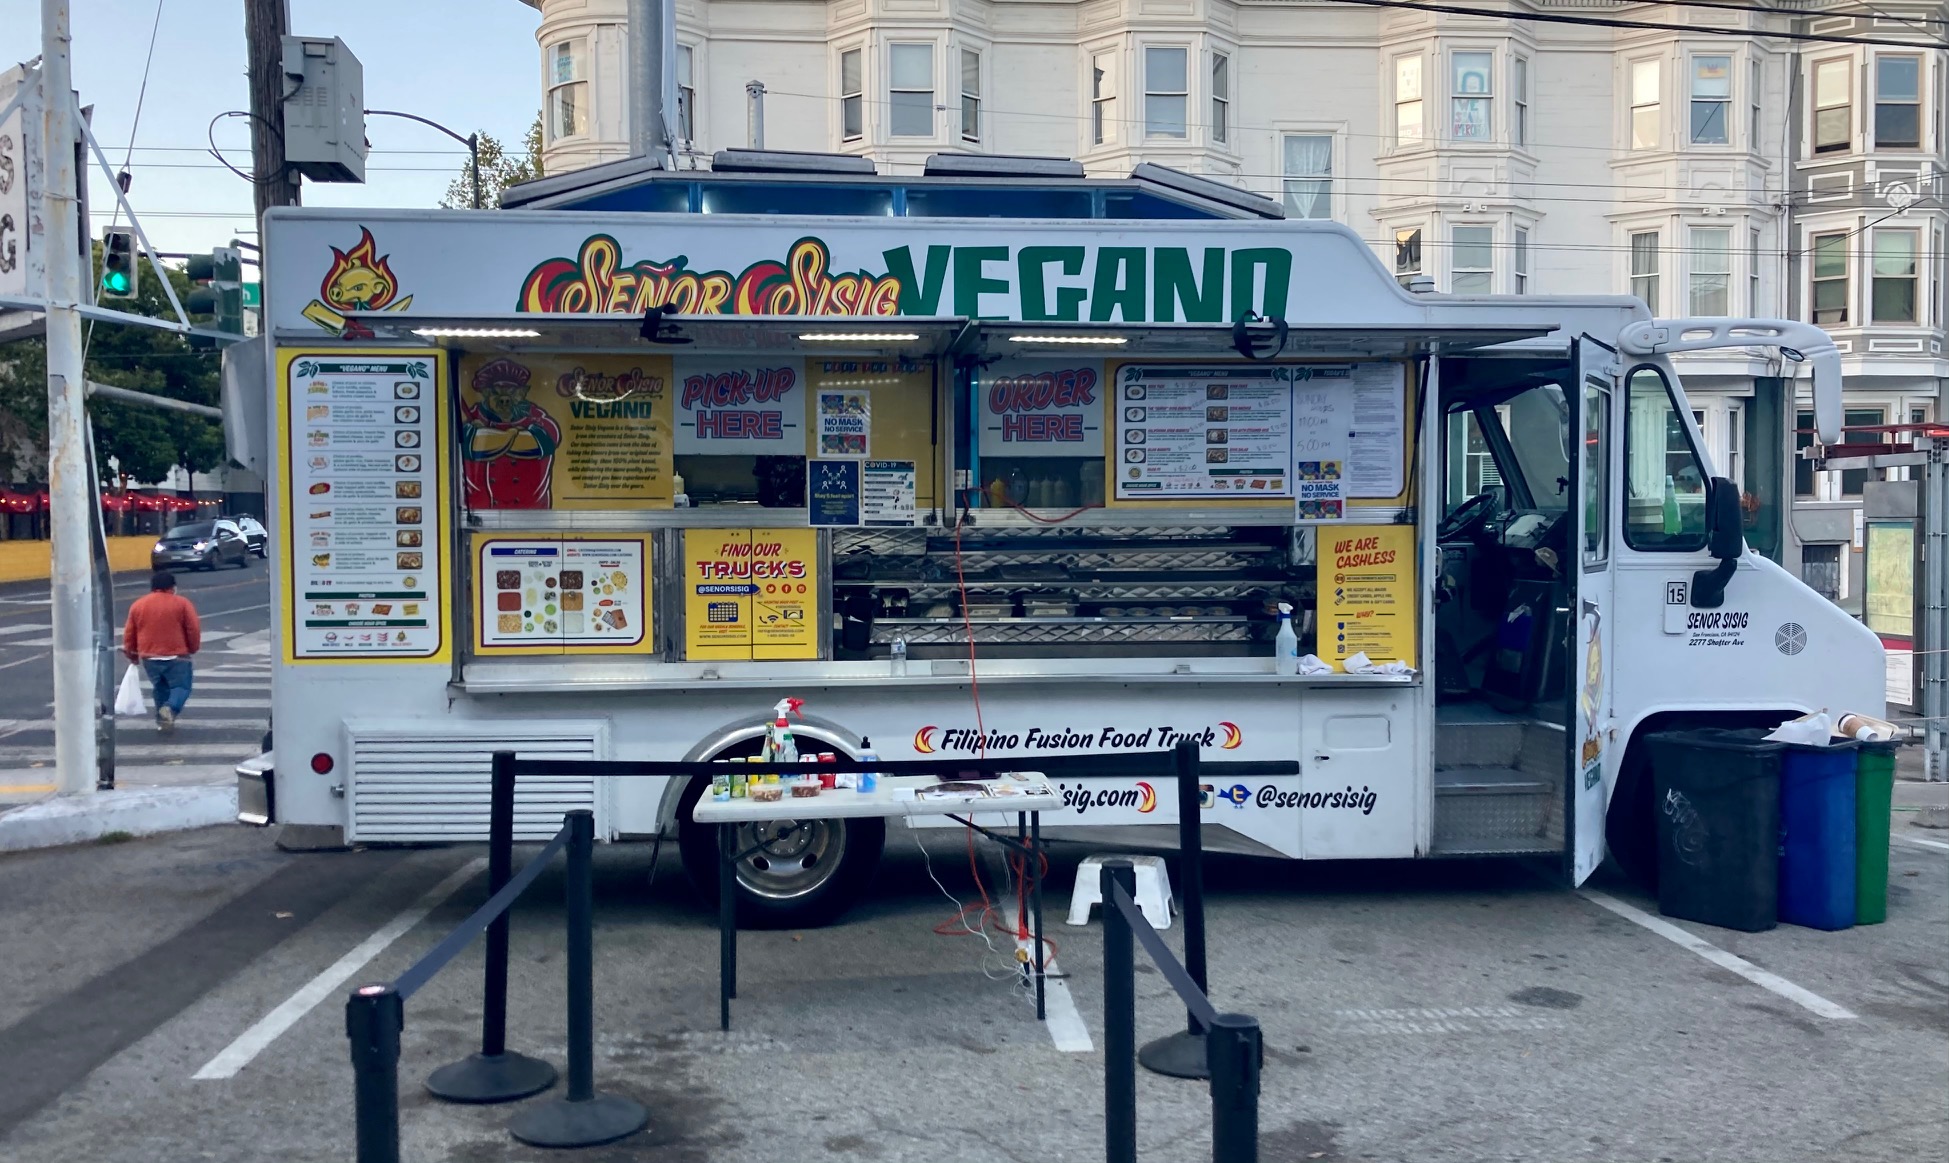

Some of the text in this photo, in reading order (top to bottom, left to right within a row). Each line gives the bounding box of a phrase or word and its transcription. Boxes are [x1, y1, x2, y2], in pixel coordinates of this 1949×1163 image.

[755, 237, 903, 316] SISIG
[883, 245, 1292, 322] VEGANO
[682, 367, 796, 410] PICK-UP
[989, 368, 1097, 414] ORDER
[570, 400, 652, 419] VEGANO
[697, 410, 783, 439] HERE
[1003, 414, 1084, 442] HERE
[720, 543, 782, 557] FIND OUR
[1334, 537, 1379, 553] WE ARE
[1336, 550, 1396, 569] CASHLESS
[696, 560, 806, 579] TRUCKS
[698, 586, 750, 594] @SENORSISIG
[1670, 588, 1684, 602] 15
[1356, 610, 1374, 618] WHY?
[1687, 612, 1749, 629] SENOR SISIG
[941, 726, 1215, 753] Filipino Fusion Food Truck
[1060, 784, 1138, 814] sig.com
[1256, 784, 1378, 815] @senorsisig
